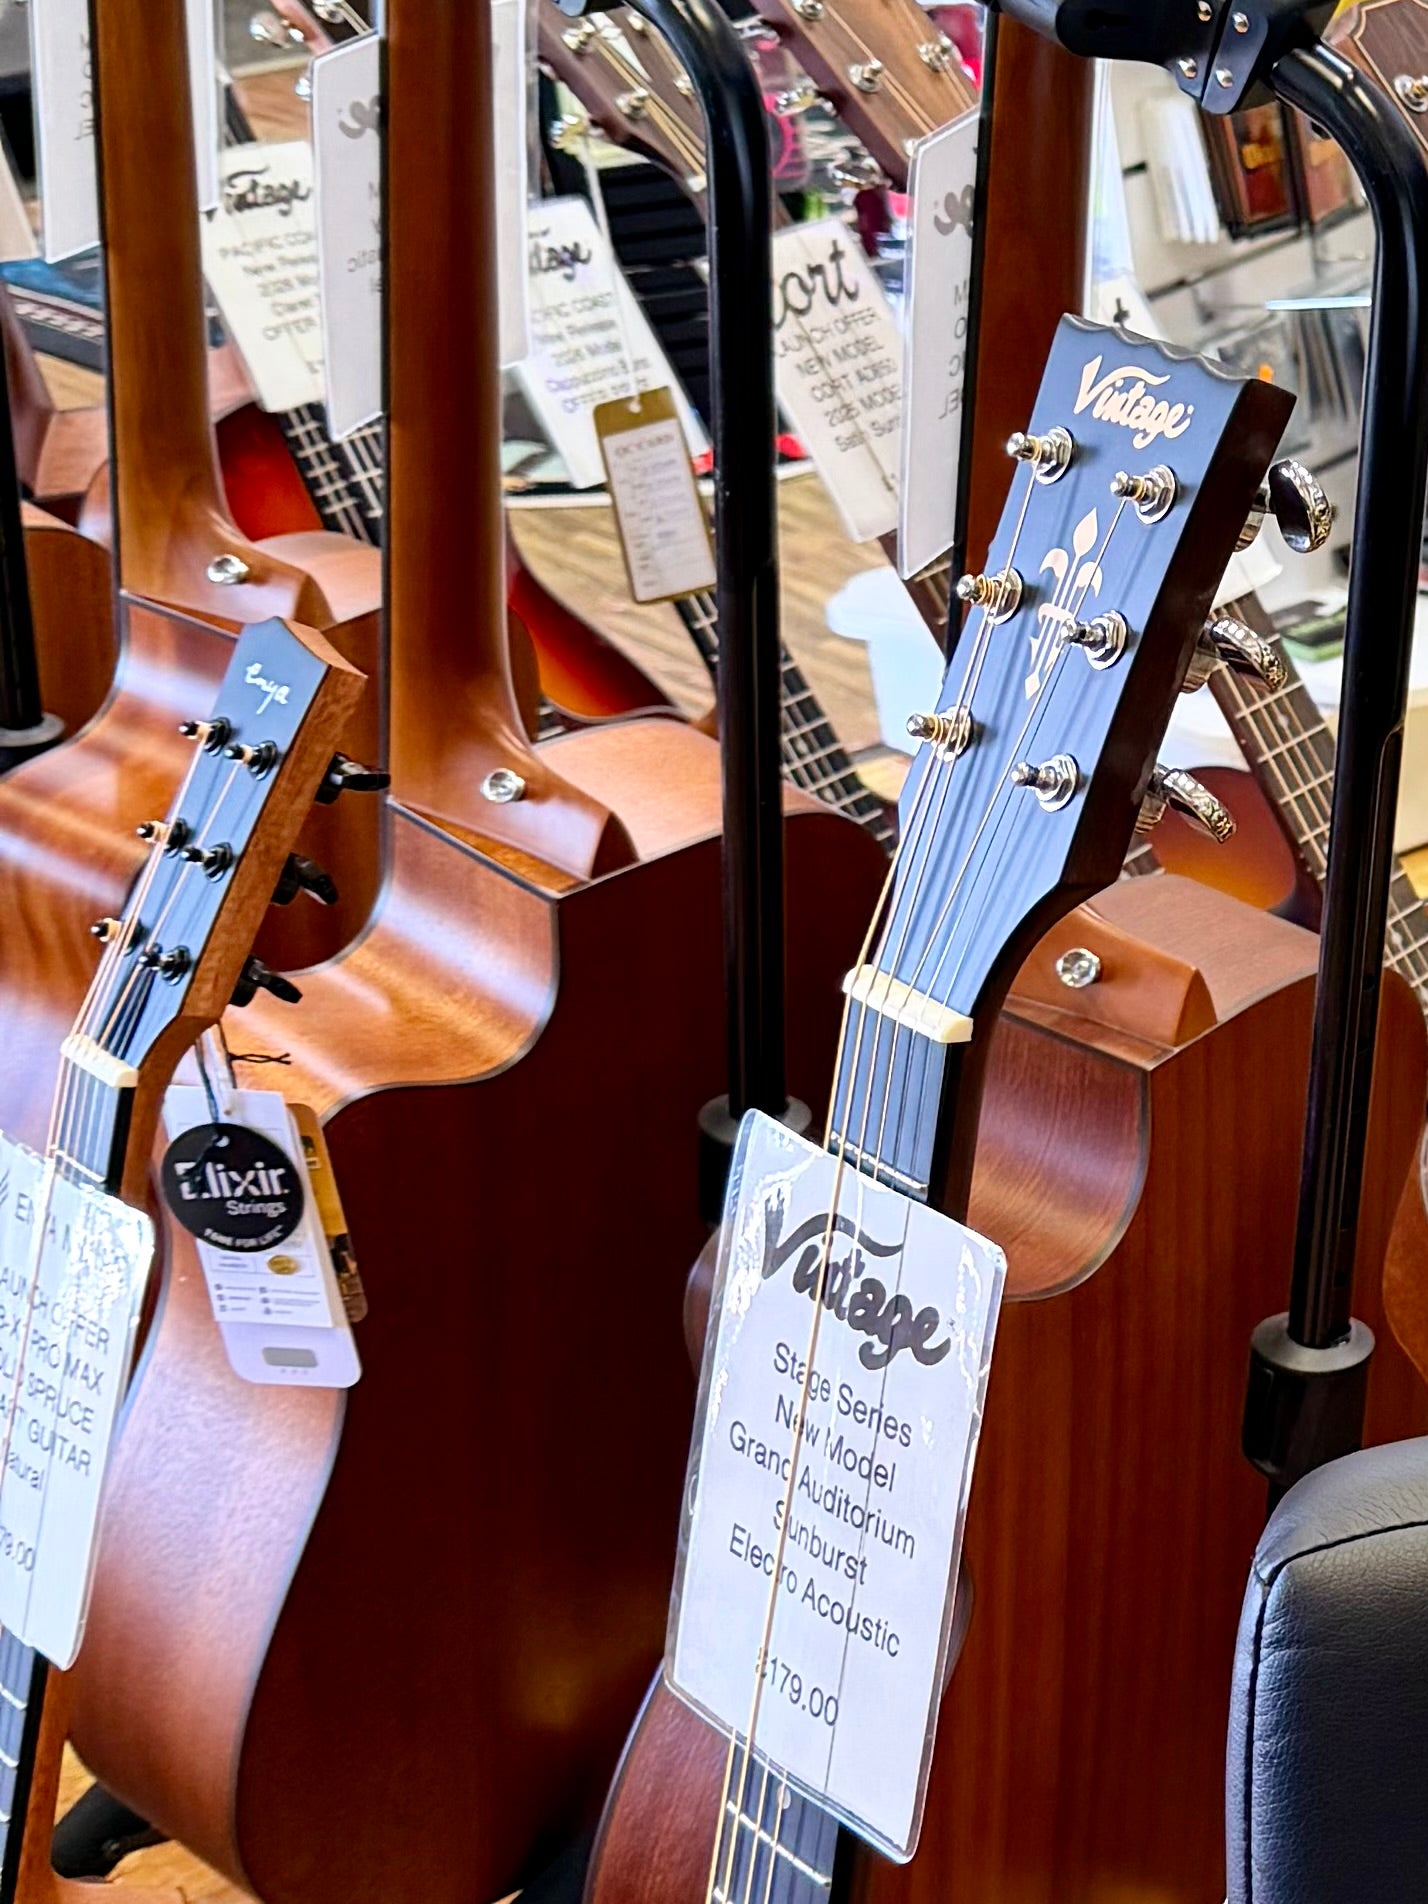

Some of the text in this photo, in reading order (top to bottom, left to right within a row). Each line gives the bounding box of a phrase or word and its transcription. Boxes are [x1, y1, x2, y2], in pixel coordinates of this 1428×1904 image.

[832, 306, 882, 337] OFFER
[795, 334, 886, 380] NEW MODEL
[810, 374, 855, 403] CORT
[1073, 353, 1195, 451] Vintage
[173, 1160, 290, 1202] Elixir
[224, 1198, 288, 1219] Strings
[759, 1184, 953, 1372] Vintage
[29, 1337, 106, 1397] PRO MAX
[772, 1340, 914, 1449] Stage Series
[25, 1370, 97, 1436] SPRUCE
[26, 1416, 94, 1479] GUITAR
[775, 1392, 897, 1494] New Model
[773, 1498, 869, 1586] Sunburst
[797, 1464, 917, 1561] Auditorium
[728, 1522, 901, 1659] Elecro Acoustic
